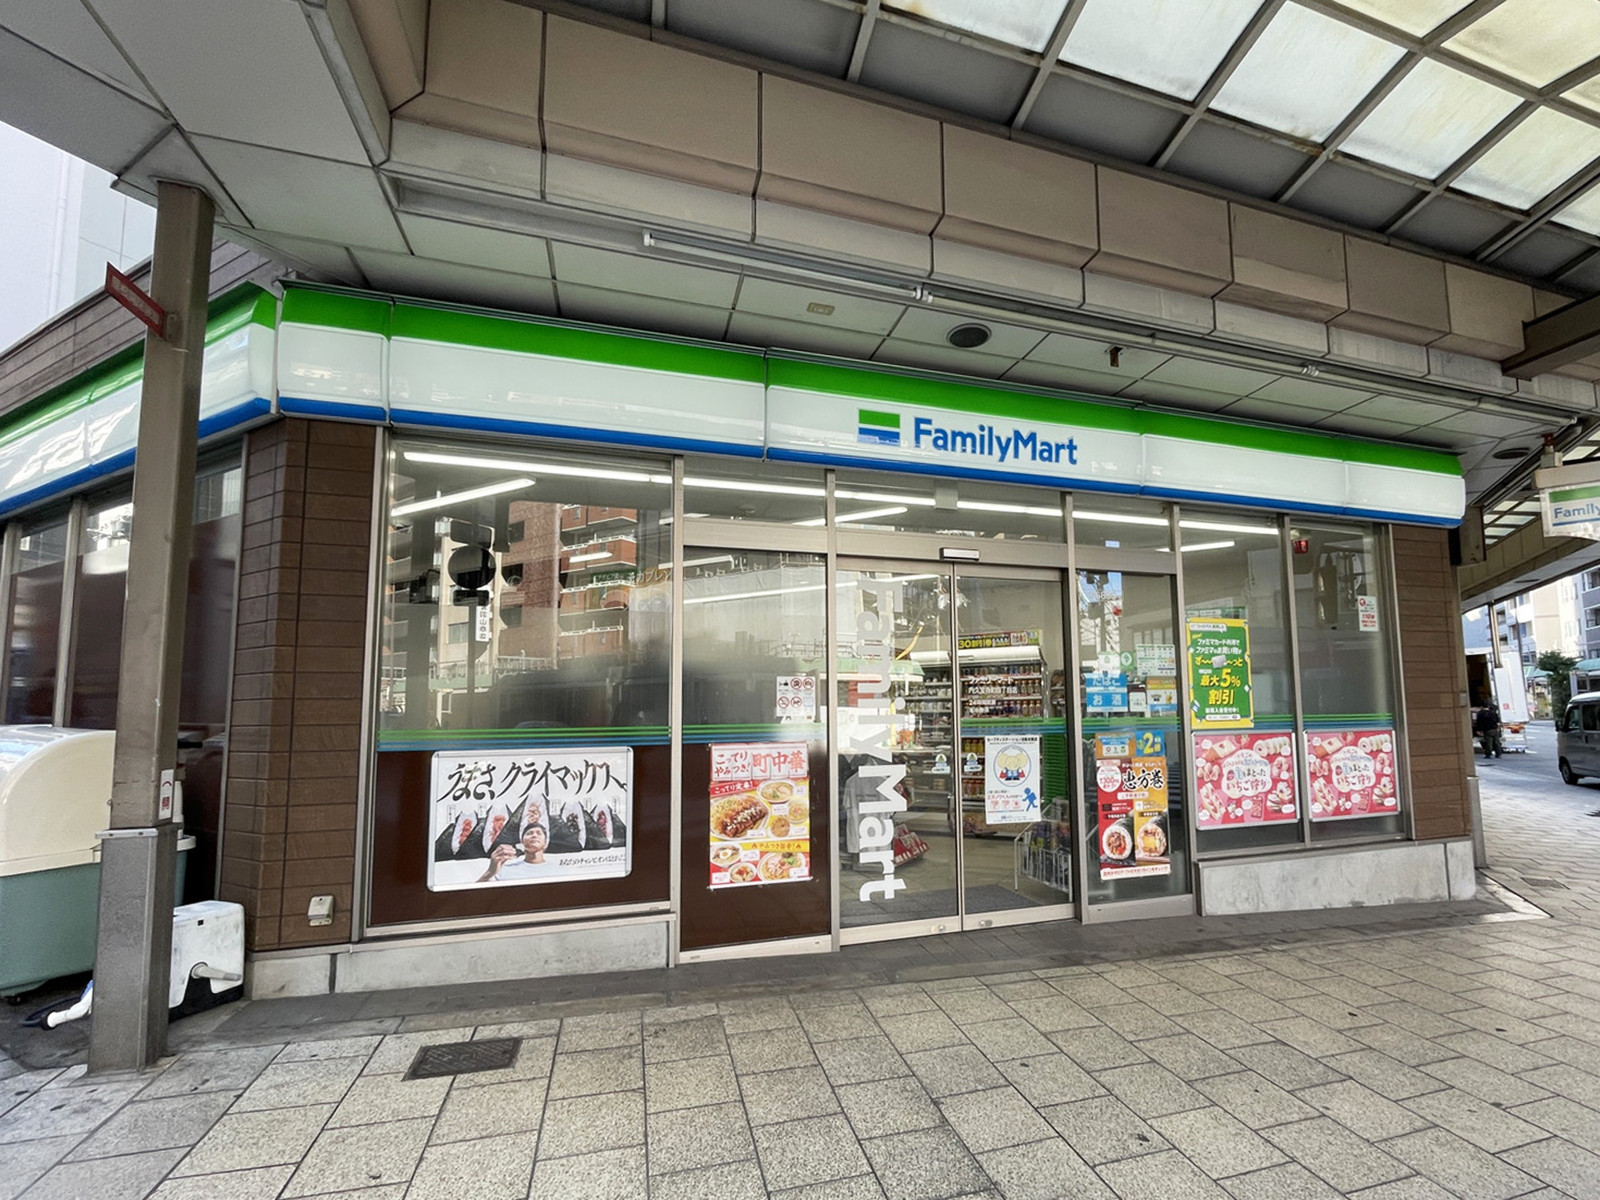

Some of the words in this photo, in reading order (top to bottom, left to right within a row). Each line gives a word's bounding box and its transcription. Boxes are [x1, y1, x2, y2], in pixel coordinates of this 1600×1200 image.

[913, 416, 1078, 465] FamilyMart
[850, 579, 908, 903] FamilyMart
[716, 750, 748, 766] こってり
[752, 750, 805, 774] 町中華
[1123, 768, 1164, 790] 恵方巻
